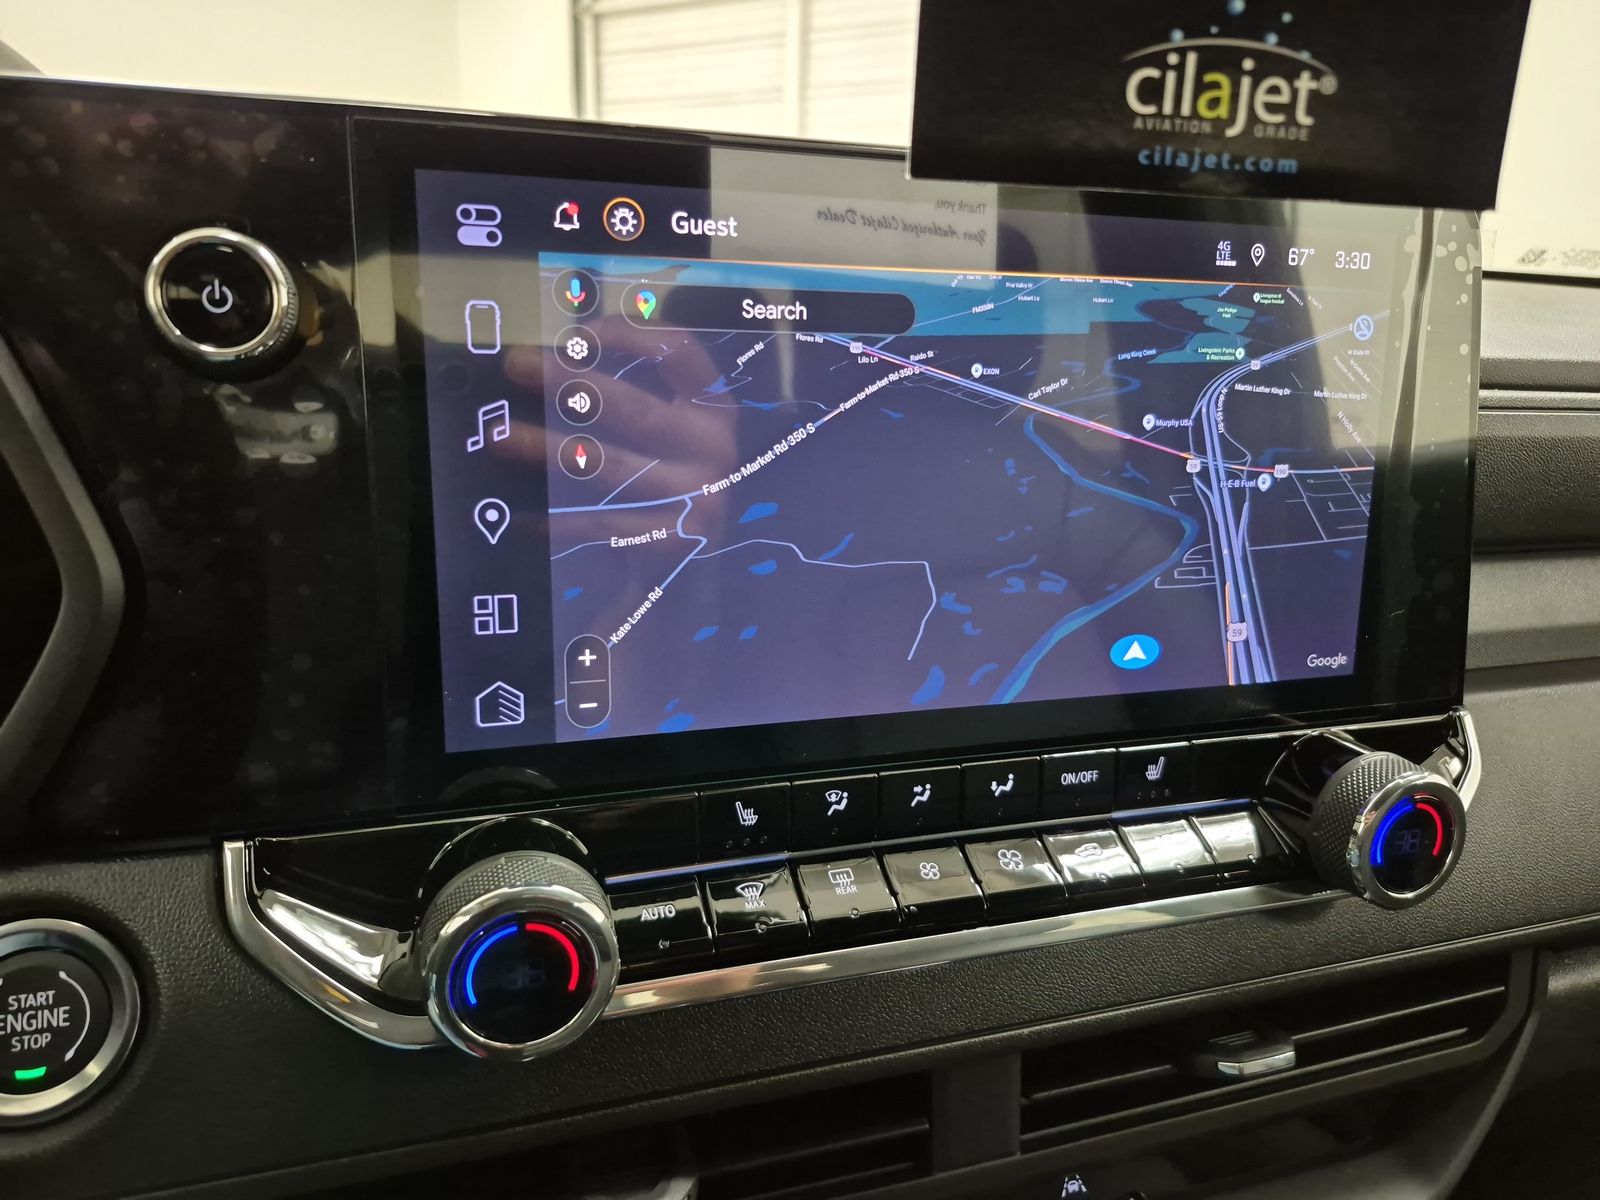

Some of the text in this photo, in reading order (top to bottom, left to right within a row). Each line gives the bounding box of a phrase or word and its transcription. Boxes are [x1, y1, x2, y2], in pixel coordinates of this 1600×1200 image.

[1133, 116, 1309, 141] AVIATION GRADE
[1138, 145, 1298, 173] cilajet.com
[671, 211, 738, 238] Guest
[1216, 250, 1231, 260] LTE
[1217, 241, 1231, 251] 4G
[1335, 251, 1370, 270] 3:30
[741, 299, 808, 321] Search
[753, 341, 765, 353] Rd
[840, 396, 859, 412] Farm
[864, 377, 889, 396] Market
[898, 367, 913, 378] 350
[1040, 382, 1060, 397] Taylor
[1234, 382, 1291, 395] Martin Luther King Dr
[1155, 418, 1193, 429] Murphy USA
[702, 421, 816, 496] Farm to Market Rd 350 S
[1241, 479, 1256, 487] Fuel
[610, 528, 667, 548] Earnest Rd
[609, 586, 663, 645] Kate Lowe Rd
[1306, 652, 1347, 669] Google
[1061, 770, 1099, 785] ON/OFF
[835, 885, 858, 895] REAR
[640, 904, 676, 922] AUTO
[744, 899, 767, 910] MAX
[8, 990, 56, 1011] START
[11, 1033, 51, 1052] STOP
